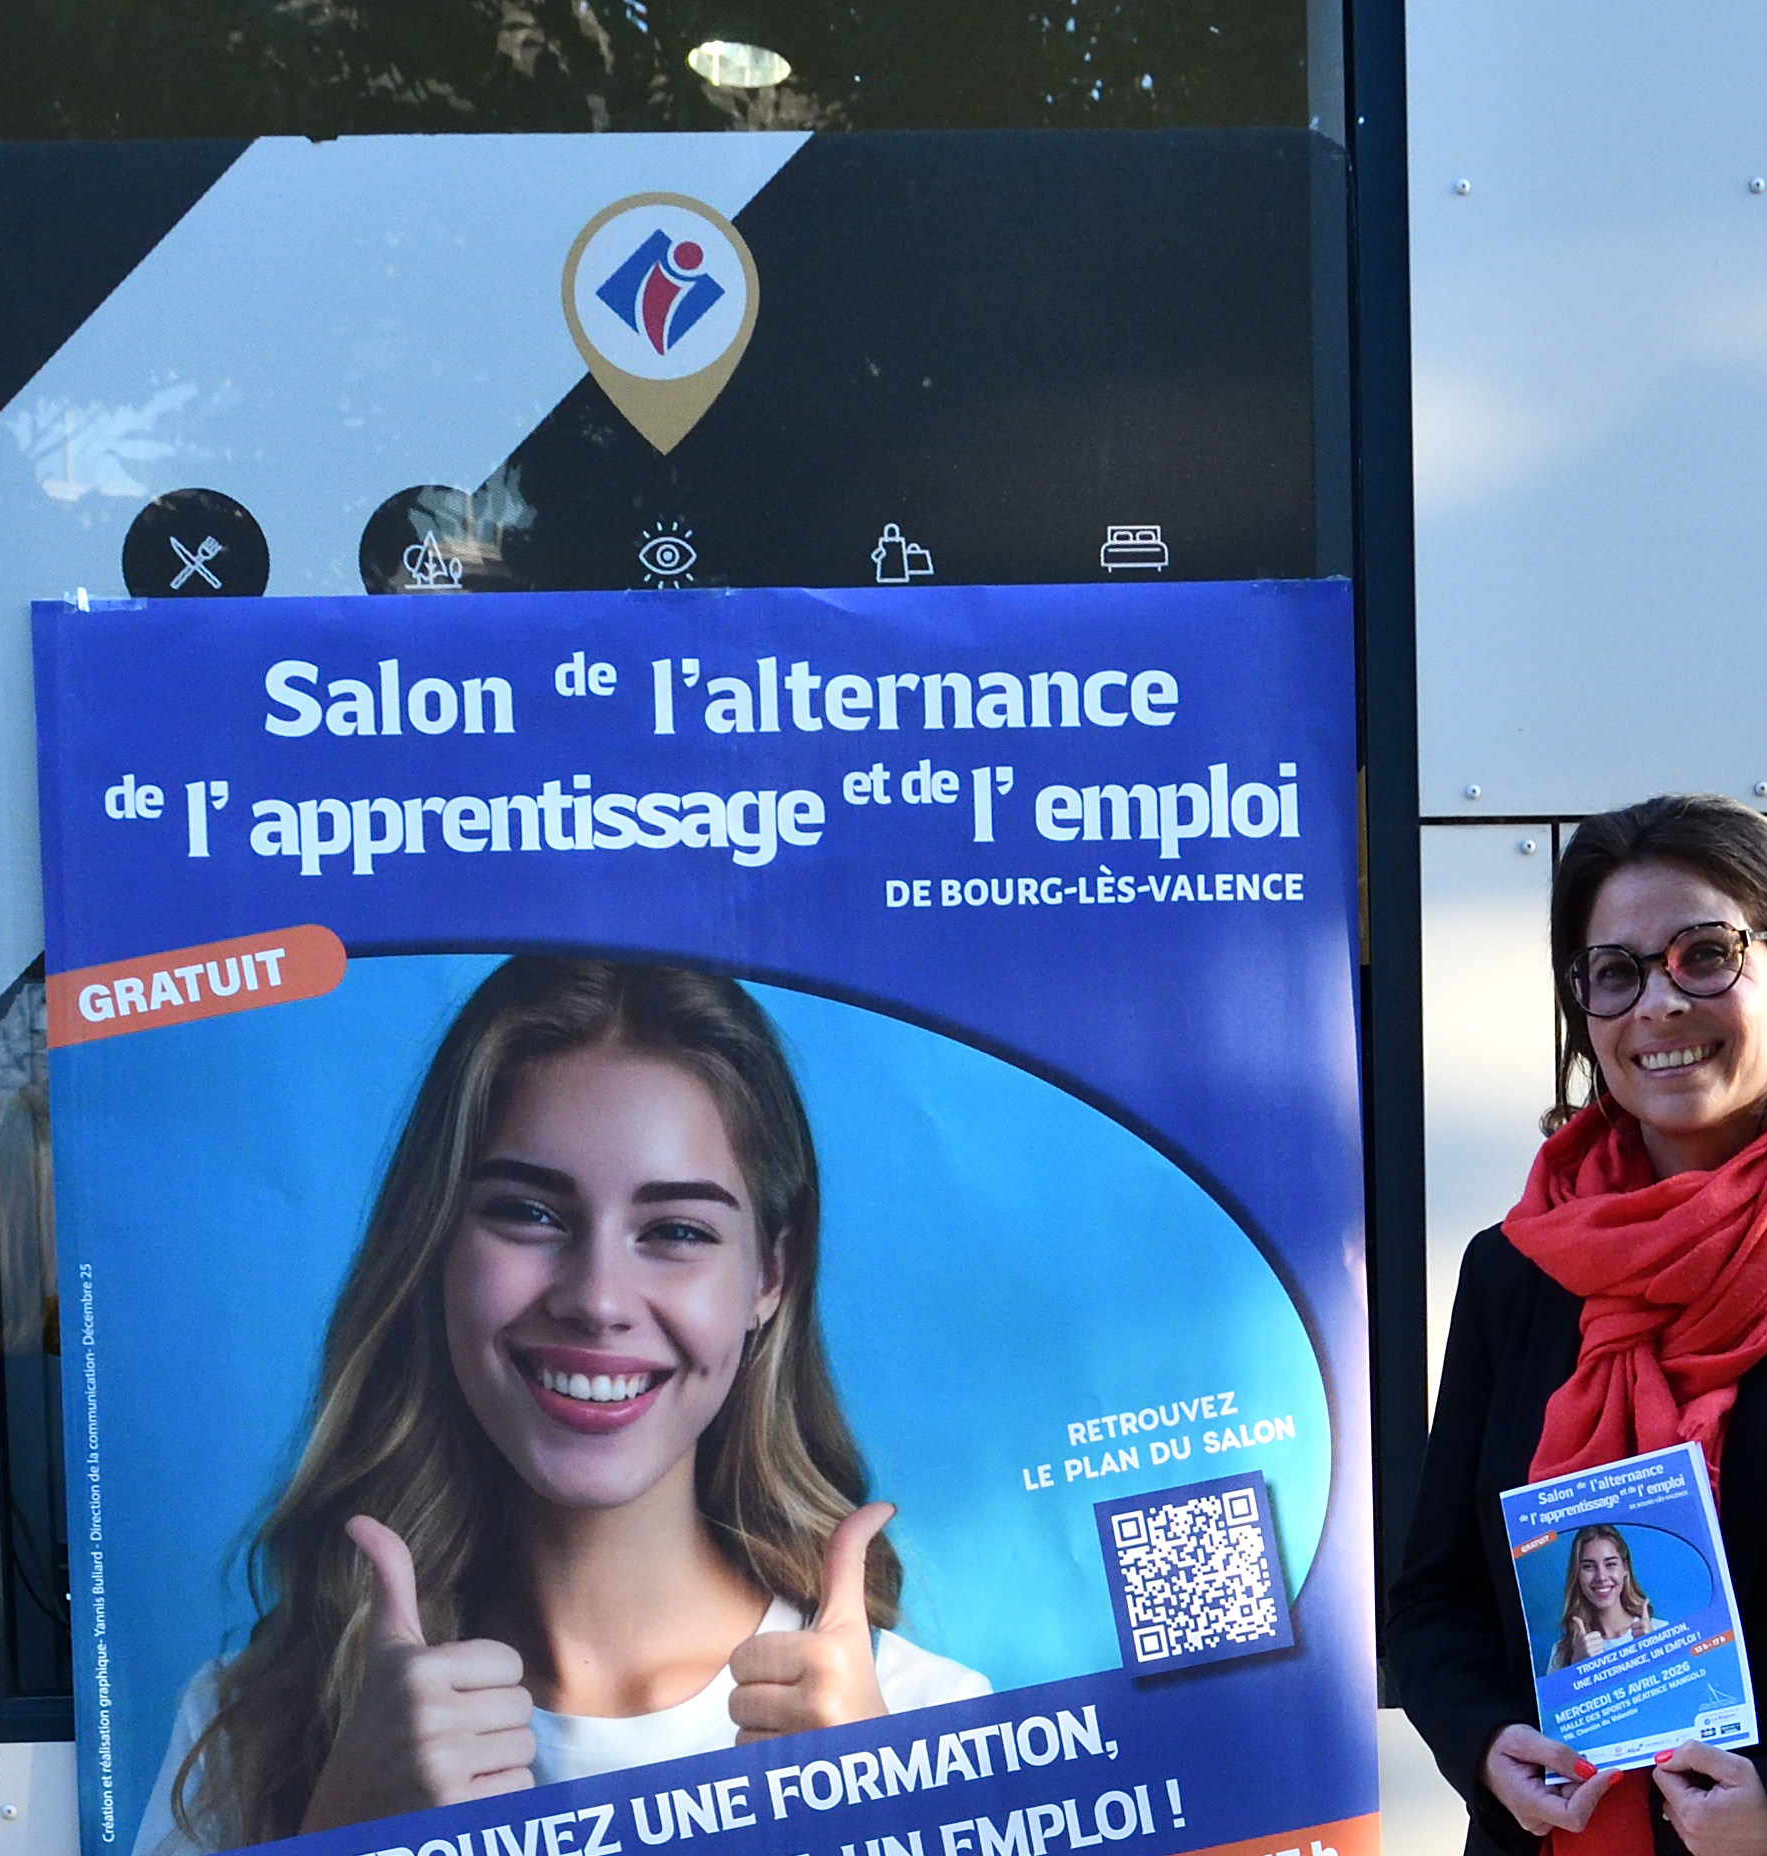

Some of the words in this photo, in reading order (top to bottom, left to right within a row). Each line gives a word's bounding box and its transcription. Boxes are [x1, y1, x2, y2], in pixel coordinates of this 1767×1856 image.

[264, 658, 515, 737] Salon
[554, 651, 616, 697] de
[651, 656, 1179, 734] l'alternance
[104, 773, 164, 819] de
[185, 779, 228, 857] l'
[249, 774, 825, 875] apprentissage
[842, 762, 891, 804] et
[901, 758, 959, 804] de
[1034, 762, 1299, 870] emploi
[885, 879, 932, 907] DE
[940, 865, 1304, 906] BOURG-LÈS-VALENCE
[78, 946, 288, 1026] GRATUIT
[79, 1263, 92, 1278] 25
[79, 1281, 94, 1345] Décembre
[1066, 1390, 1238, 1446] RETROUVEZ
[85, 1451, 99, 1463] la
[86, 1465, 100, 1482] de
[1022, 1463, 1054, 1491] LE
[1063, 1445, 1140, 1482] PLAN
[1148, 1435, 1191, 1466] DU
[1202, 1414, 1295, 1453] SALON
[89, 1484, 102, 1541] Direction
[1537, 1487, 1574, 1505] Salon
[1588, 1464, 1663, 1492] l'alternance
[92, 1596, 106, 1637] Yannis
[1554, 1692, 1612, 1724] MERCREDI
[1612, 1686, 1626, 1700] 15
[1626, 1672, 1660, 1694] AVRIL
[1659, 1659, 1691, 1680] 2026
[97, 1709, 112, 1773] réalisation
[100, 1775, 112, 1788] et
[629, 1775, 756, 1845] UNE
[765, 1704, 1118, 1819] FORMATION,
[100, 1789, 115, 1843] Création
